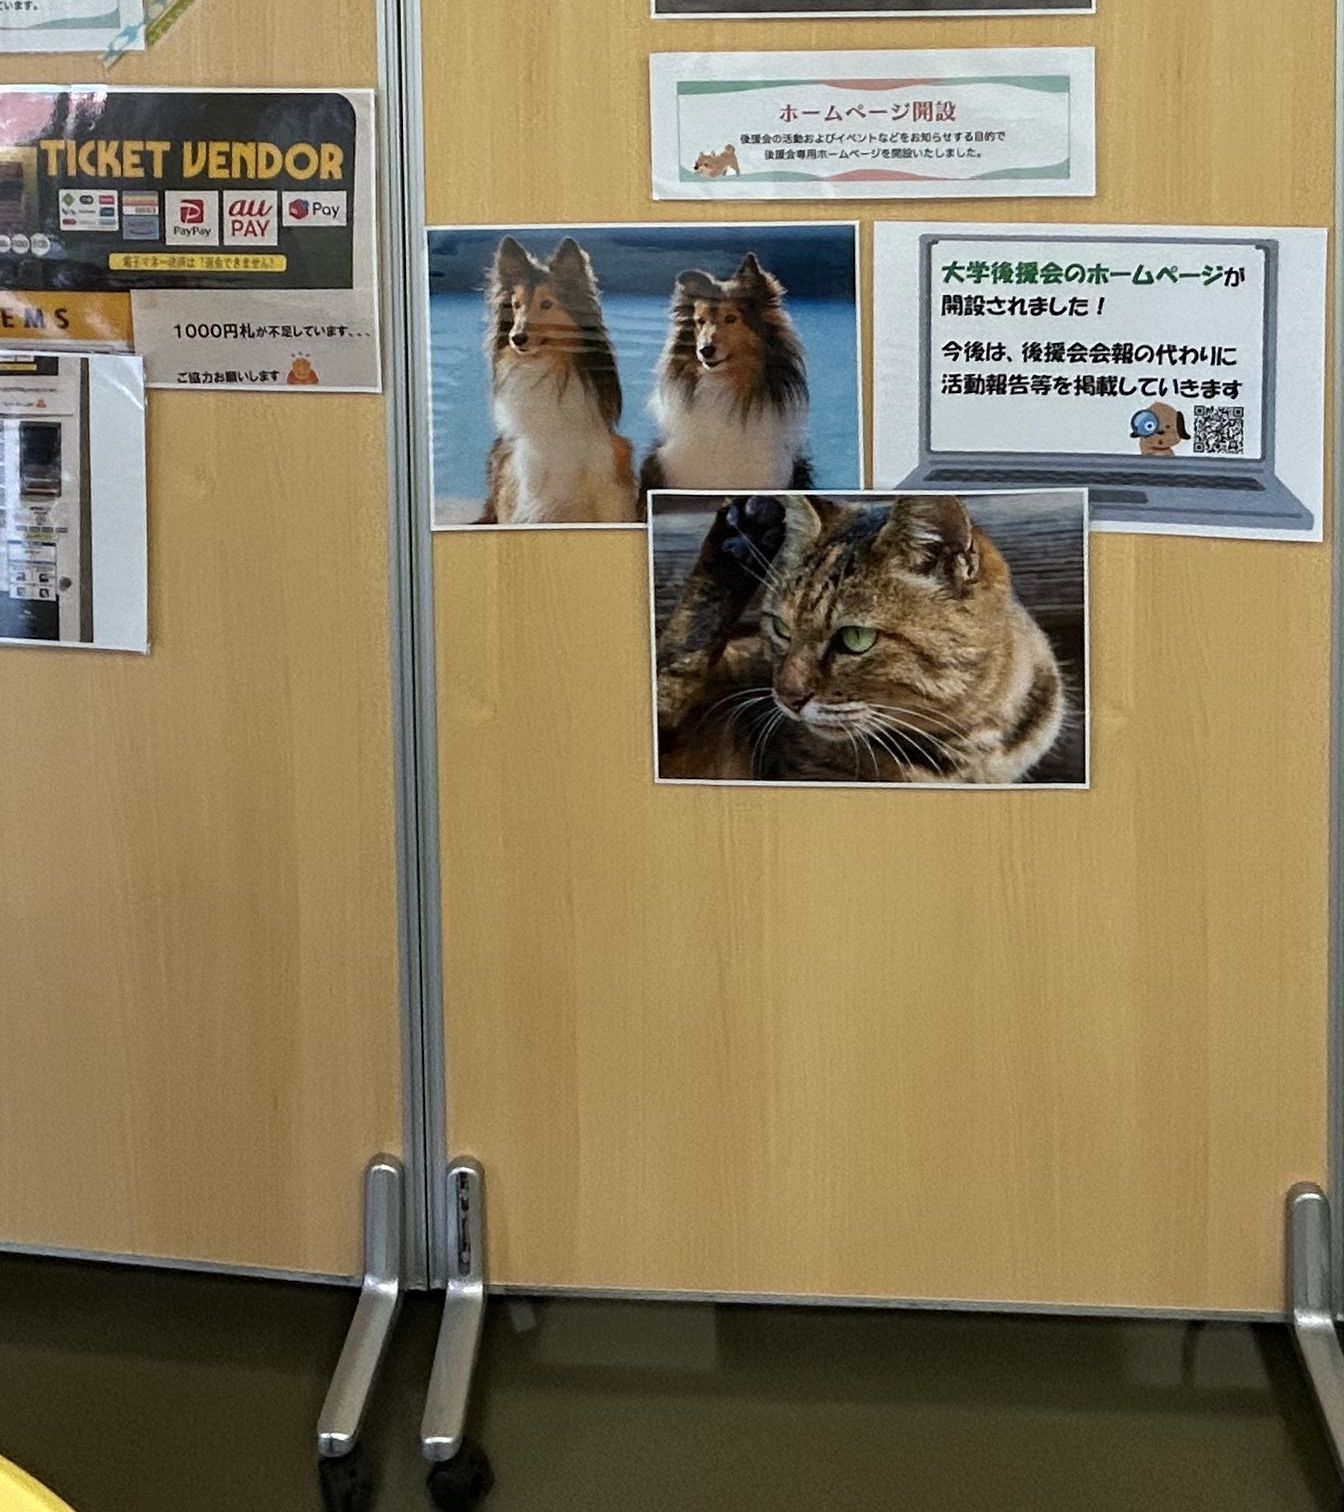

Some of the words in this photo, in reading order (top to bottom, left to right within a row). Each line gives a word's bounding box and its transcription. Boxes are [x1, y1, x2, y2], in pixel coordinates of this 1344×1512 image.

[780, 101, 956, 122] ホームページ開設
[40, 140, 171, 178] TICKET
[182, 140, 344, 181] VENDOR
[312, 201, 340, 219] Pay
[173, 226, 212, 237] PayPay
[231, 219, 270, 237] PAY
[941, 261, 1245, 288] 大学後援会のホームページが
[941, 295, 1105, 316] 開設されました！
[941, 341, 1237, 366] 今後は、後援会会報の代わりに
[176, 370, 280, 384] ご協力お願いします
[941, 374, 1243, 399] 活動報告等を掲載していきます
